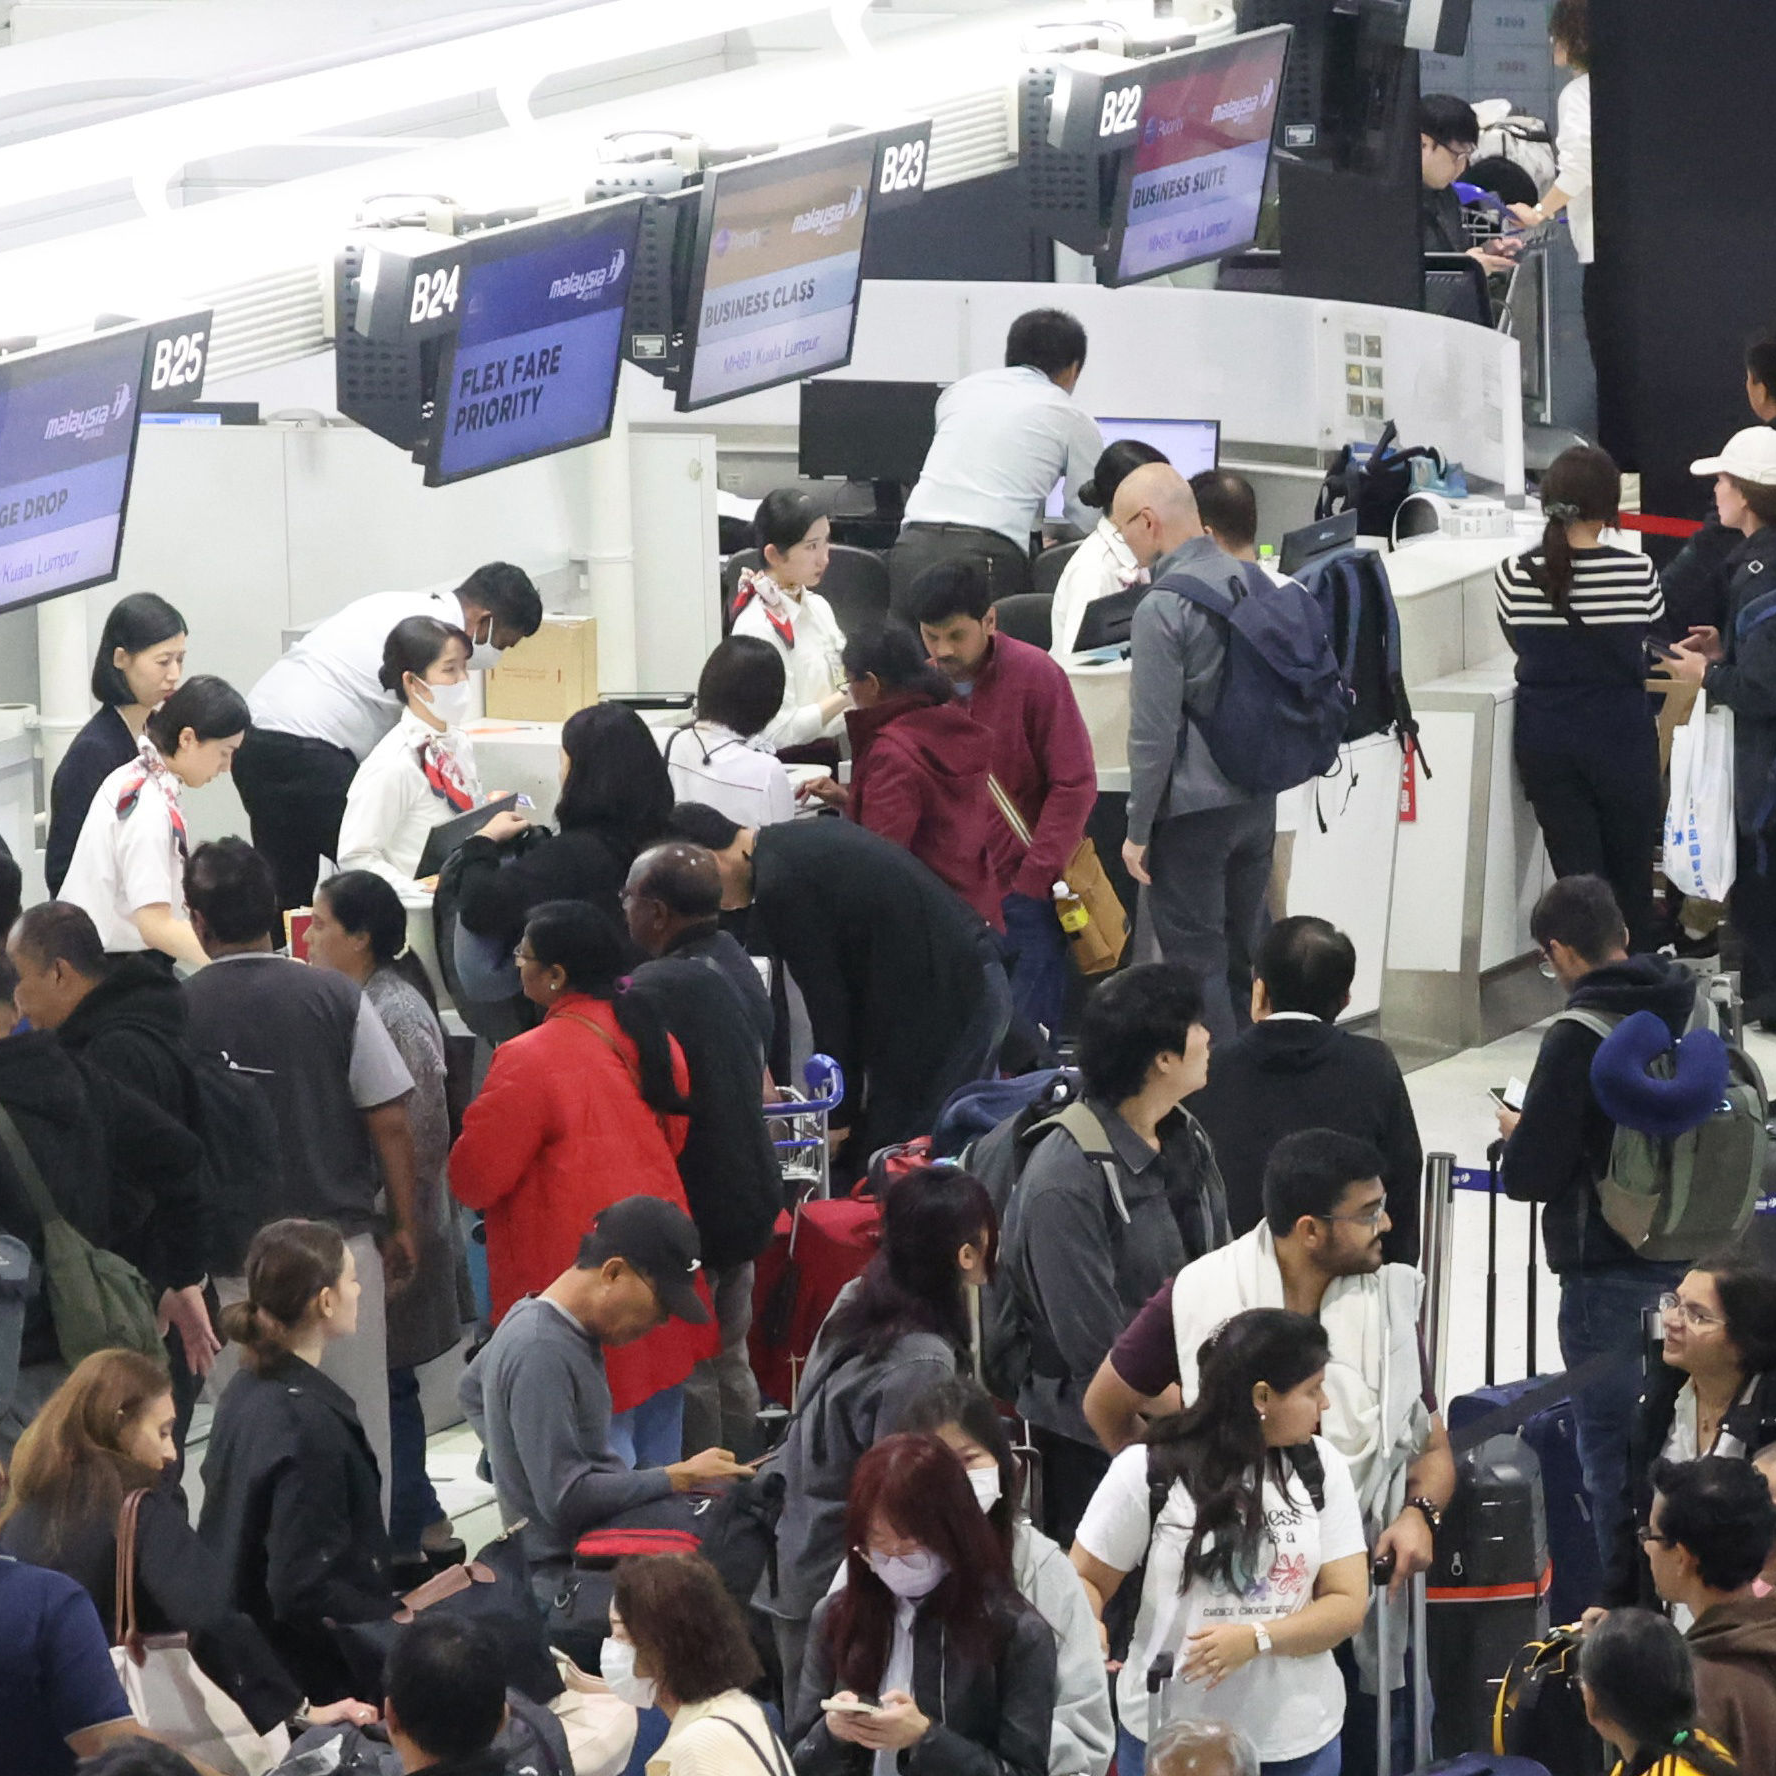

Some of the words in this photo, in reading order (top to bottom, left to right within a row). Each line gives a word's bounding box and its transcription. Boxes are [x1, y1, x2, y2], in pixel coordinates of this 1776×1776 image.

[1099, 85, 1142, 137] B22
[880, 140, 924, 194] B23
[1133, 174, 1190, 209] BUSINESS
[1191, 164, 1227, 193] SUITE
[791, 203, 847, 233] malaysia
[410, 265, 460, 323] B24
[549, 267, 607, 299] malaysia
[705, 292, 770, 328] BUSINESS
[773, 278, 816, 301] CLASS
[152, 332, 205, 392] B25
[459, 359, 508, 396] FLEX
[511, 345, 561, 382] FARE
[44, 405, 109, 440] malaysia
[454, 386, 544, 437] PRIORITY
[23, 489, 68, 523] DROP
